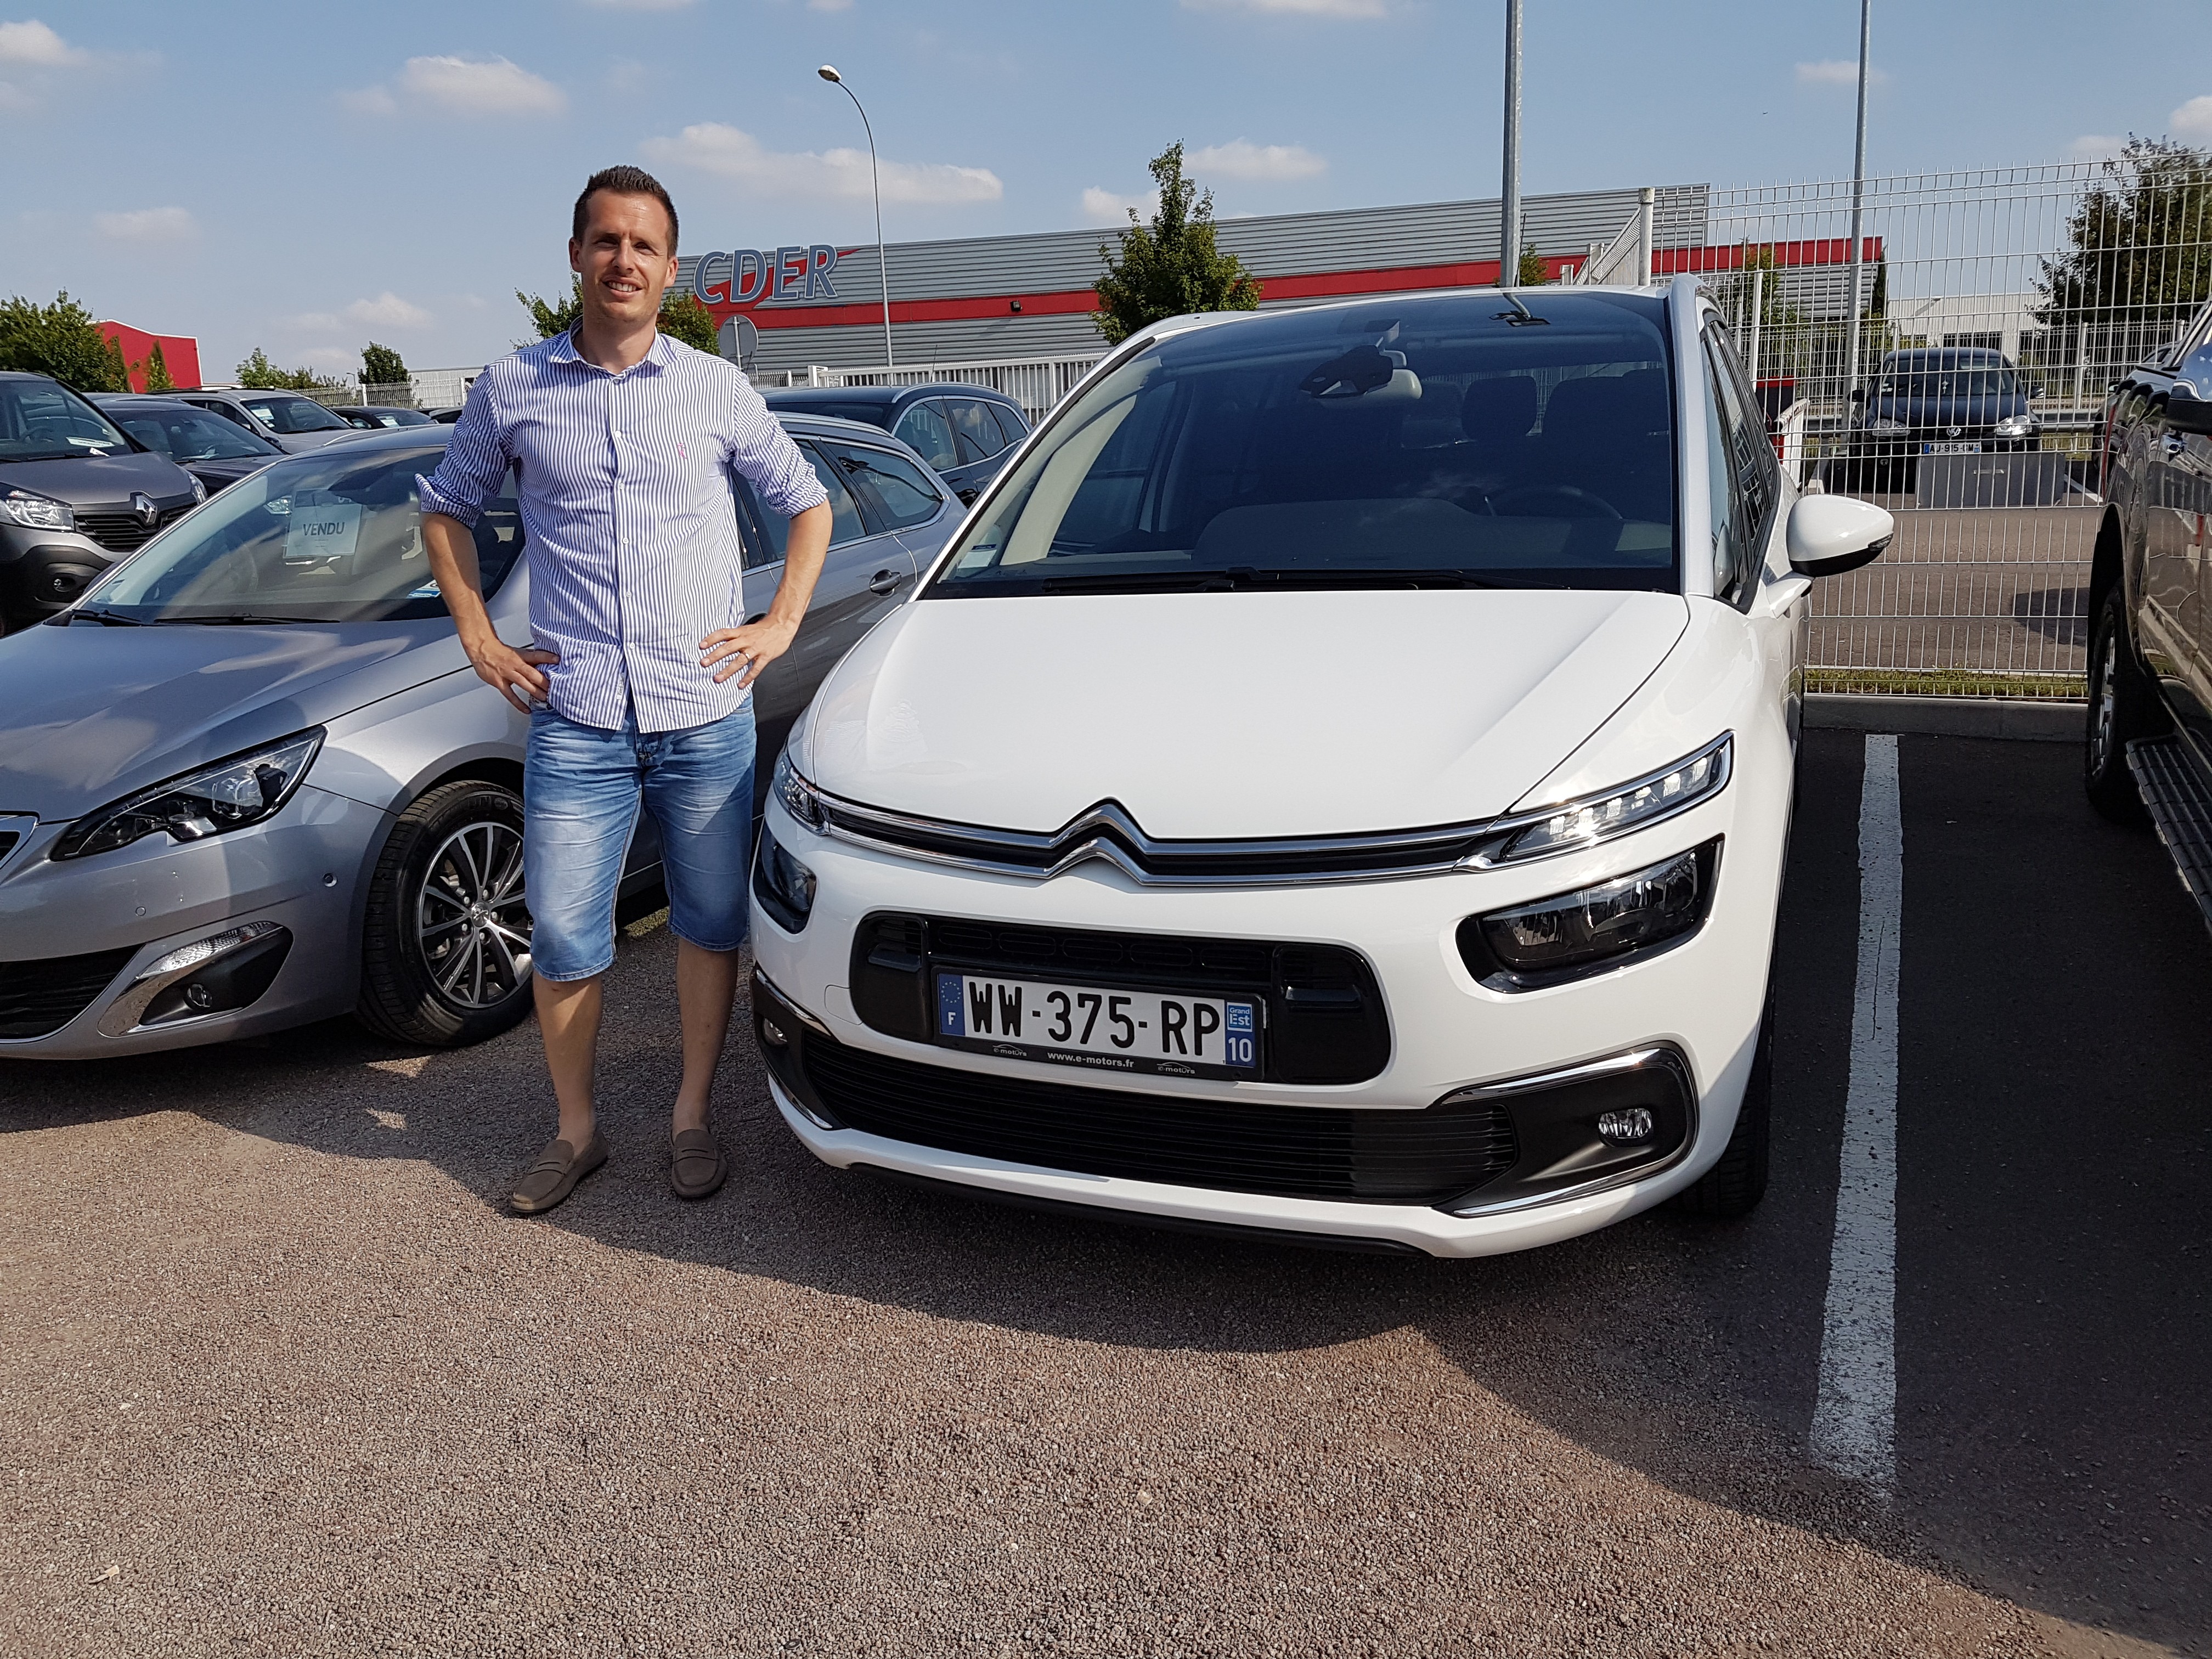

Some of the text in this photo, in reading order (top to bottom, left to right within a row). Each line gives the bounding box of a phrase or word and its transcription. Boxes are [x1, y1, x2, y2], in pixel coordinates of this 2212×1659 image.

[693, 245, 838, 304] CDER
[303, 522, 345, 536] VENDU
[948, 1012, 956, 1025] F
[969, 981, 1220, 1056] WW-375-RP
[1229, 1013, 1250, 1026] Est
[1228, 1037, 1252, 1062] 10
[1047, 1052, 1135, 1068] www.e-motors.fr
